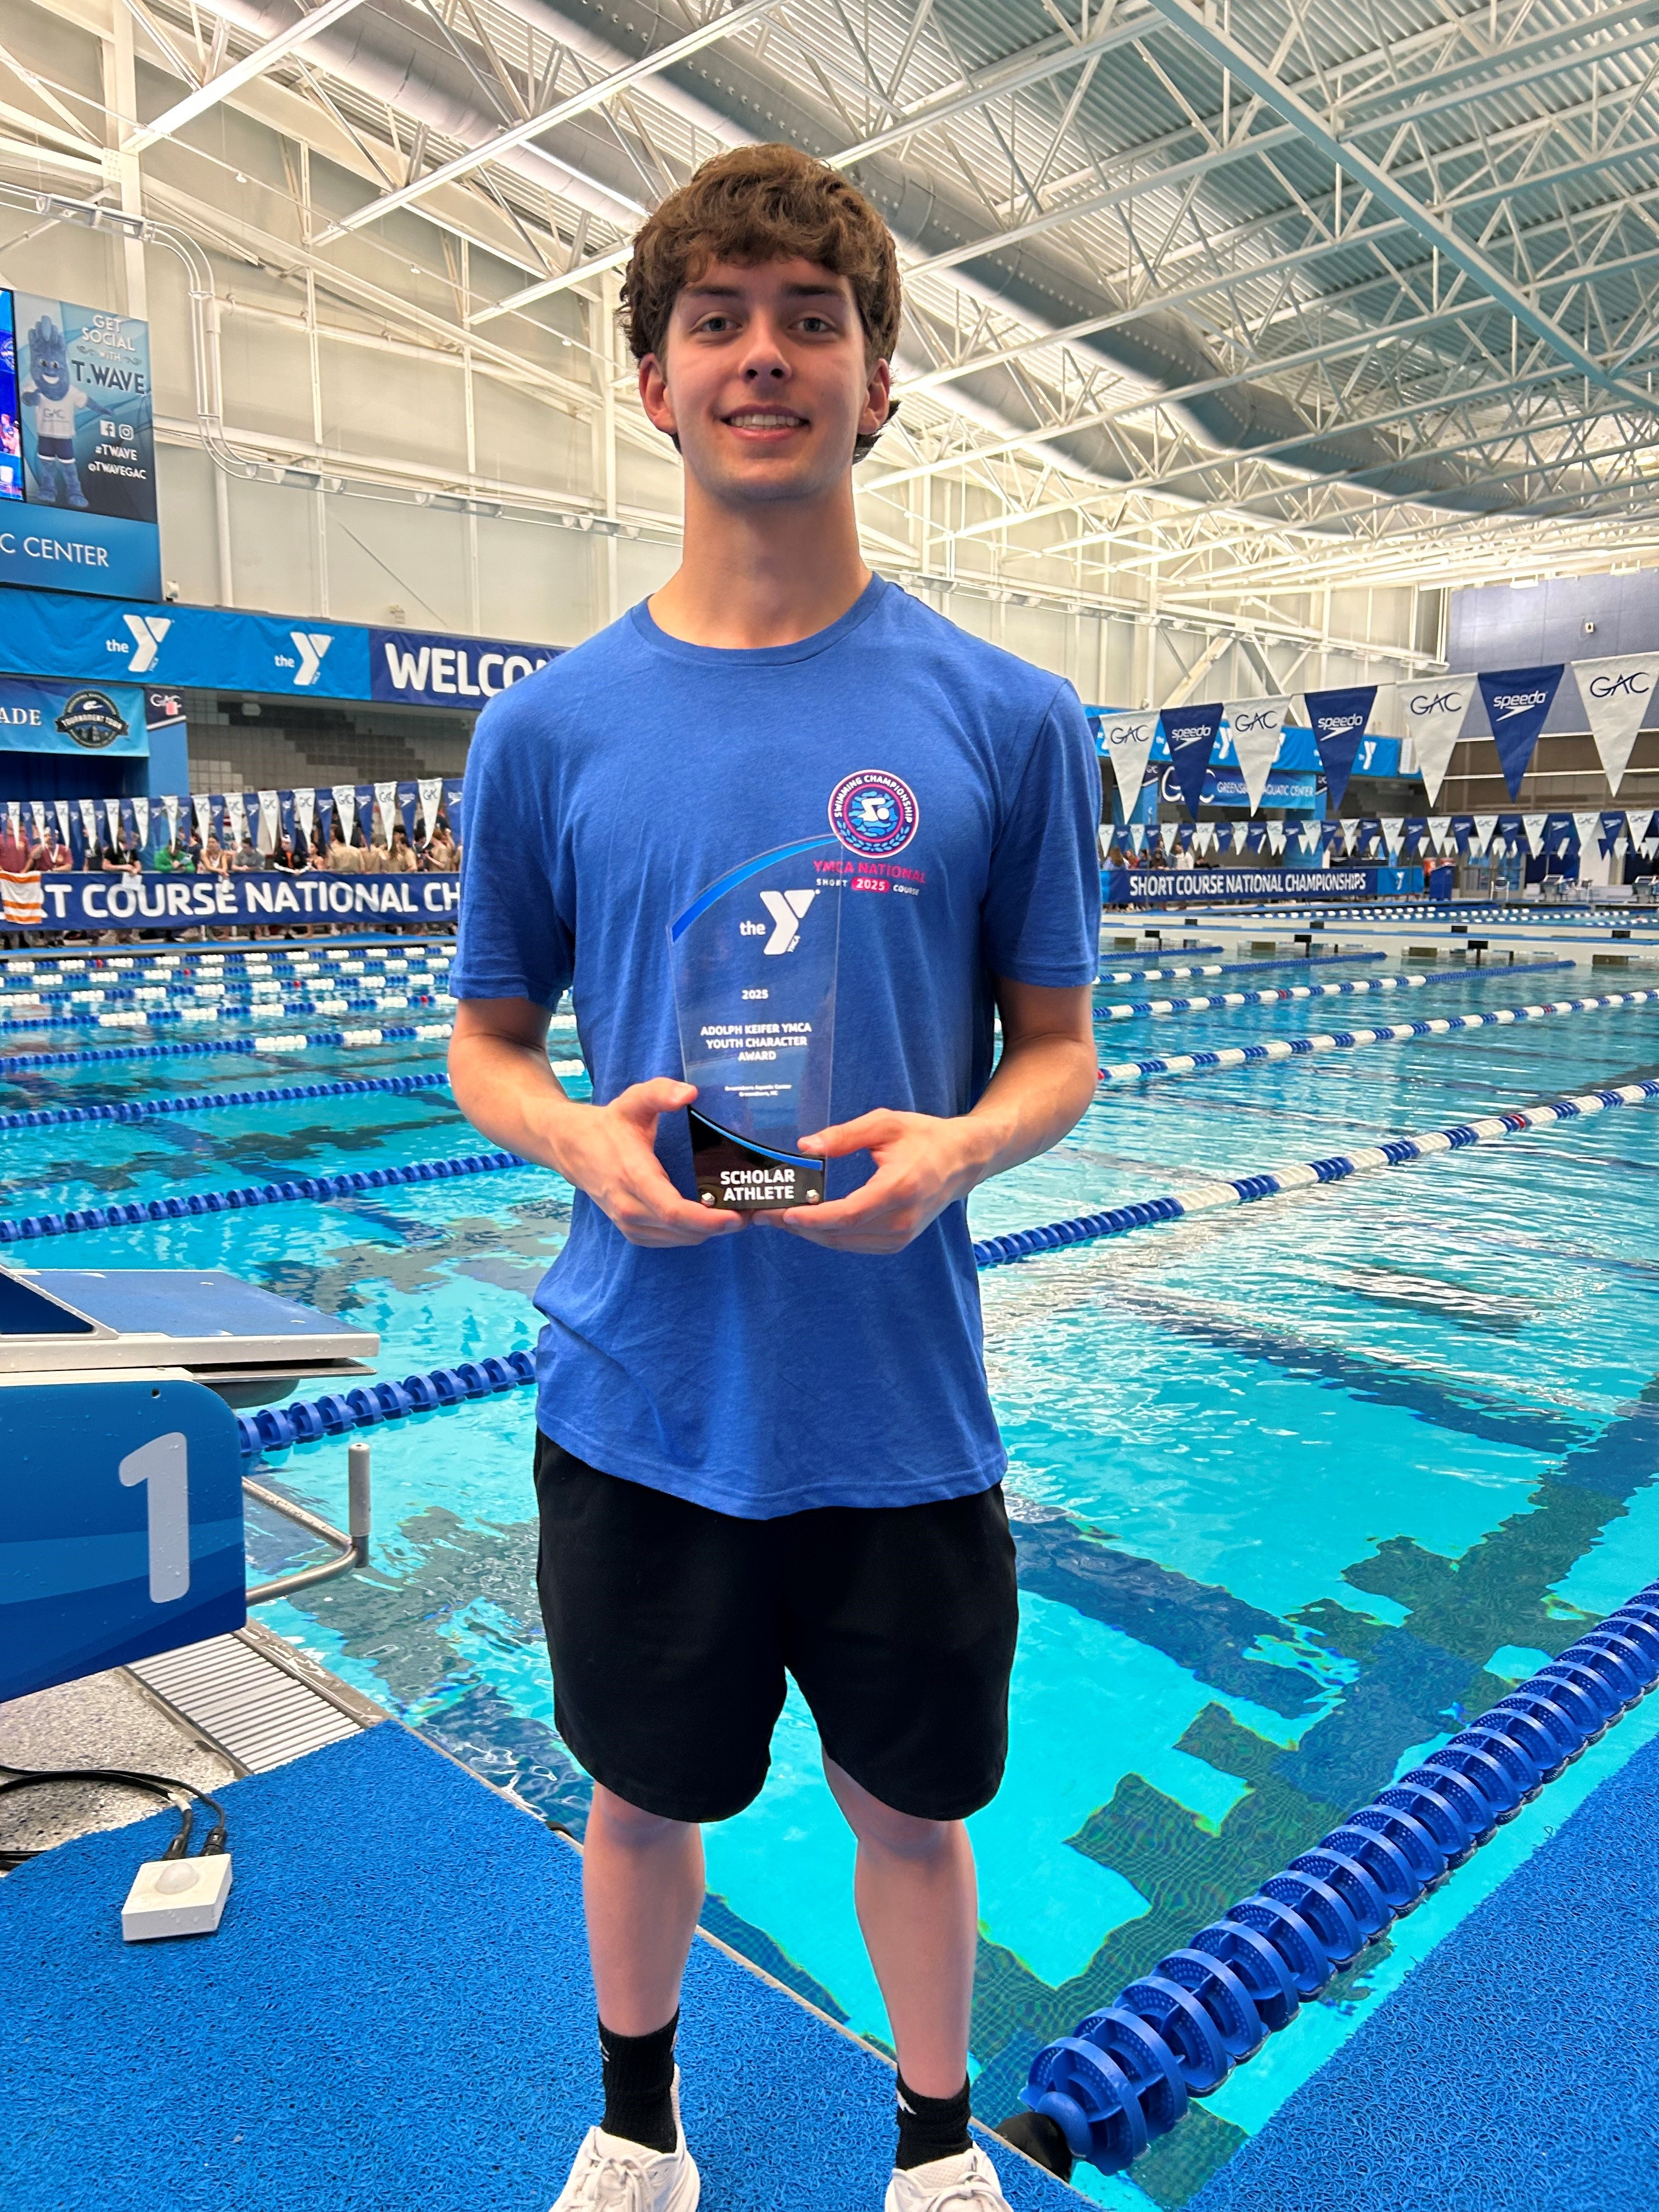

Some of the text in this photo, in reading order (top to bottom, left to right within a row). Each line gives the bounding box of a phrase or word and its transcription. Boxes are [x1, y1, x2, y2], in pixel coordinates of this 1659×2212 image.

[93, 314, 121, 332] GET
[82, 328, 136, 351] SOCIAL
[99, 349, 121, 361] WITH
[71, 360, 146, 394] T.WAVE
[95, 443, 138, 461] #TWAVE
[88, 461, 147, 479] @TWAVEGAC
[24, 536, 109, 567] CENTER
[106, 639, 129, 653] the
[275, 655, 295, 668] the
[385, 642, 548, 697] WELCO
[1590, 672, 1650, 698] GAC
[1410, 692, 1462, 715] GAC
[1493, 691, 1546, 709] speedo
[1235, 710, 1278, 732] GAC
[1318, 714, 1363, 729] speedo
[1110, 725, 1149, 744] GAC
[1171, 725, 1211, 739] speedo
[834, 775, 913, 823] SWIMMING CHAMPIONSHIP
[814, 860, 926, 883] YMCA NATIONAL
[816, 878, 920, 896] SHORT 2025 COURSE
[1130, 872, 1367, 896] SHORT COURSE NATIONAL CHAMPIONSHIPS
[82, 882, 238, 918] COURSE
[245, 881, 419, 913] NATIONAL
[740, 921, 766, 936] the
[742, 989, 769, 1000] 2025
[700, 1023, 812, 1036] ADOLPH KEIFER YMCA
[706, 1036, 807, 1049] YOUTH CHARACTER
[738, 1050, 776, 1061] AWARD
[720, 1169, 795, 1185] SCHOLAR
[723, 1186, 794, 1201] ATHLETE
[118, 1431, 190, 1604] 1
